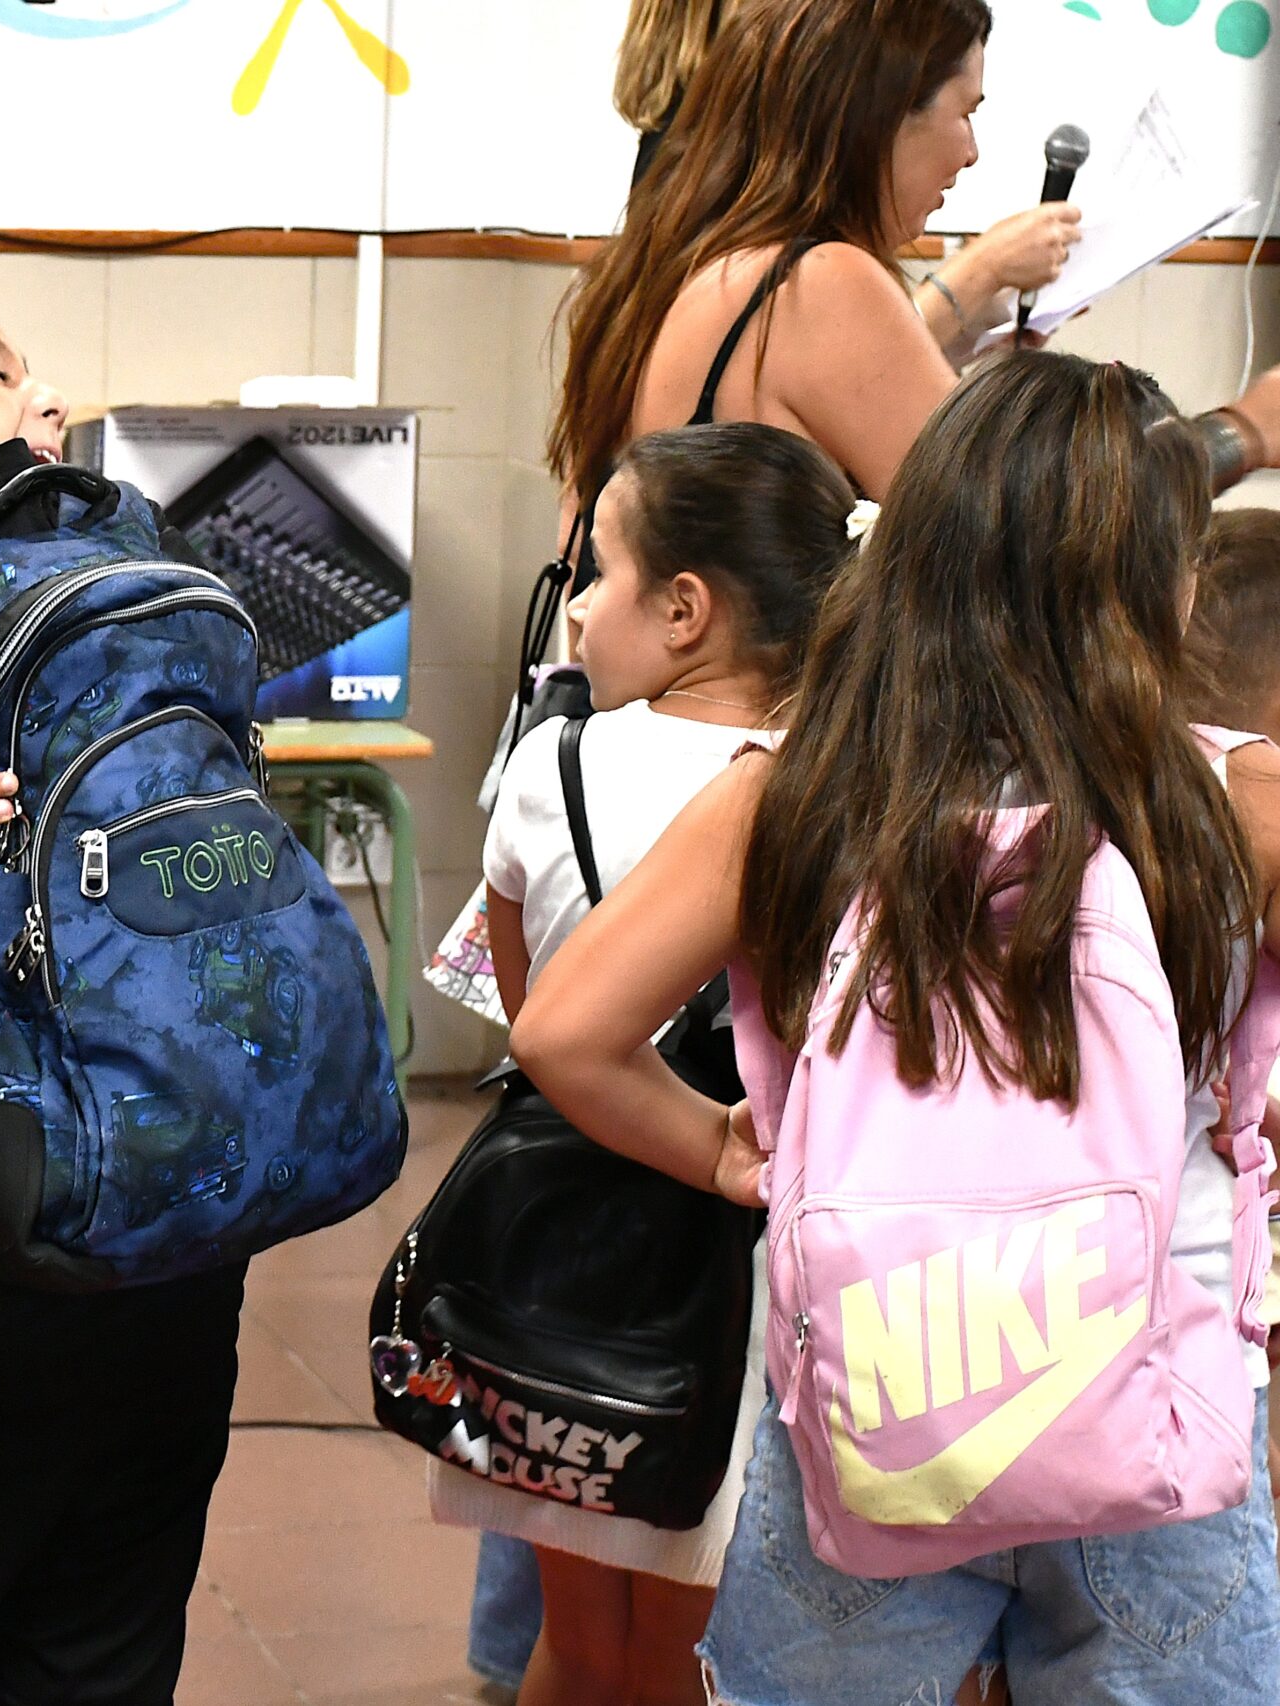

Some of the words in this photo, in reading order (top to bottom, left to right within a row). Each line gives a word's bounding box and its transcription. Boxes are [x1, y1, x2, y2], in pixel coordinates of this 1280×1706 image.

[330, 675, 402, 704] ALTO
[839, 1193, 1115, 1434] NIKE
[438, 1418, 615, 1511] MOUSE
